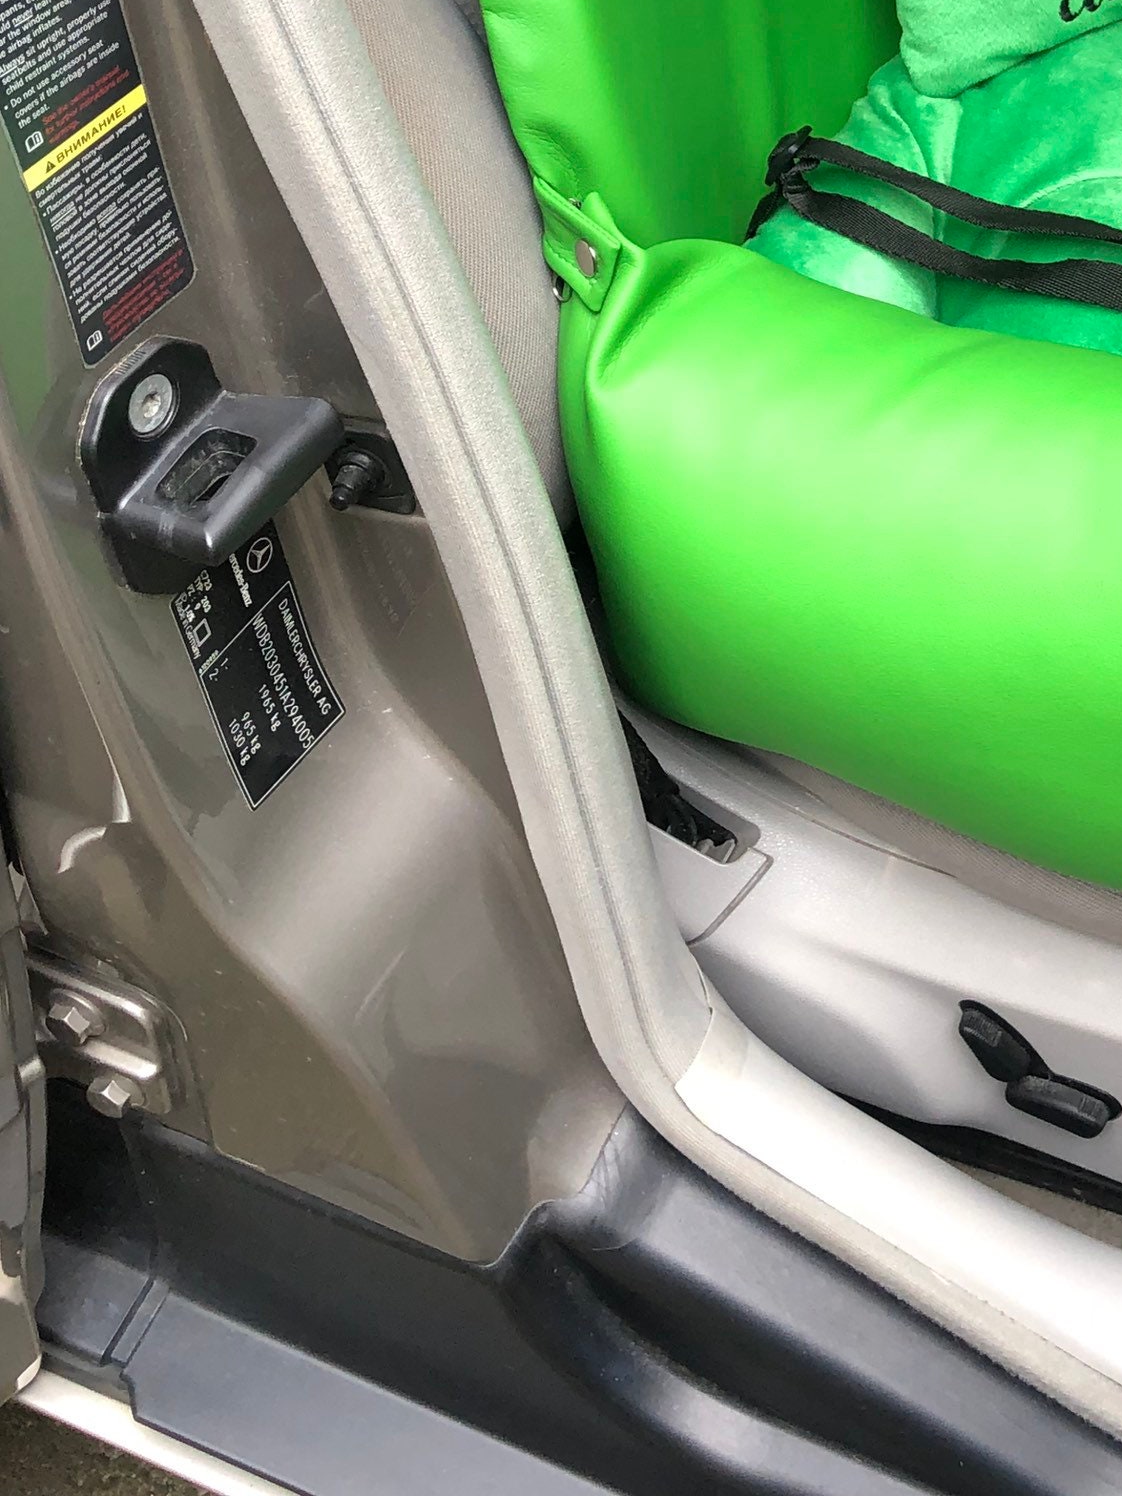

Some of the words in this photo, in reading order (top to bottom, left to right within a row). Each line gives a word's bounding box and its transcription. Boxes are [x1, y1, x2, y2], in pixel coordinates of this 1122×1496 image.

[7, 28, 20, 40] the
[21, 9, 50, 30] window
[7, 33, 32, 53] airbag
[32, 15, 62, 36] inflates.
[11, 7, 32, 25] never
[25, 45, 35, 57] sit
[36, 27, 66, 49] upright,
[66, 6, 96, 31] properly
[2, 58, 36, 84] seatbelts
[37, 46, 51, 61] and
[52, 38, 65, 51] use
[67, 11, 107, 41] appropriate
[5, 77, 24, 95] child
[24, 56, 56, 81] restraint
[57, 36, 89, 60] systems.
[9, 96, 21, 107] Do
[22, 86, 35, 99] not
[36, 77, 49, 89] use
[51, 51, 86, 80] accessory
[87, 39, 103, 54] seat
[14, 98, 39, 118] covers
[39, 91, 45, 101] if
[45, 84, 58, 96] the
[59, 65, 85, 87] airbags
[86, 57, 97, 68] are
[98, 42, 118, 59] inside
[18, 116, 31, 128] the
[32, 103, 49, 119] seat.
[56, 105, 125, 162] ВНИМАНИЕ!
[229, 553, 253, 607] ercedes-Benz
[253, 612, 314, 749] WDB2030451A294005
[278, 597, 322, 698] DAIMLERCHRYSLER
[316, 695, 331, 715] AG
[241, 711, 256, 737] 965
[250, 735, 261, 755] kg
[259, 684, 276, 715] 1965
[270, 713, 282, 732] kg
[228, 718, 245, 748] 1030
[239, 746, 251, 767] kg
